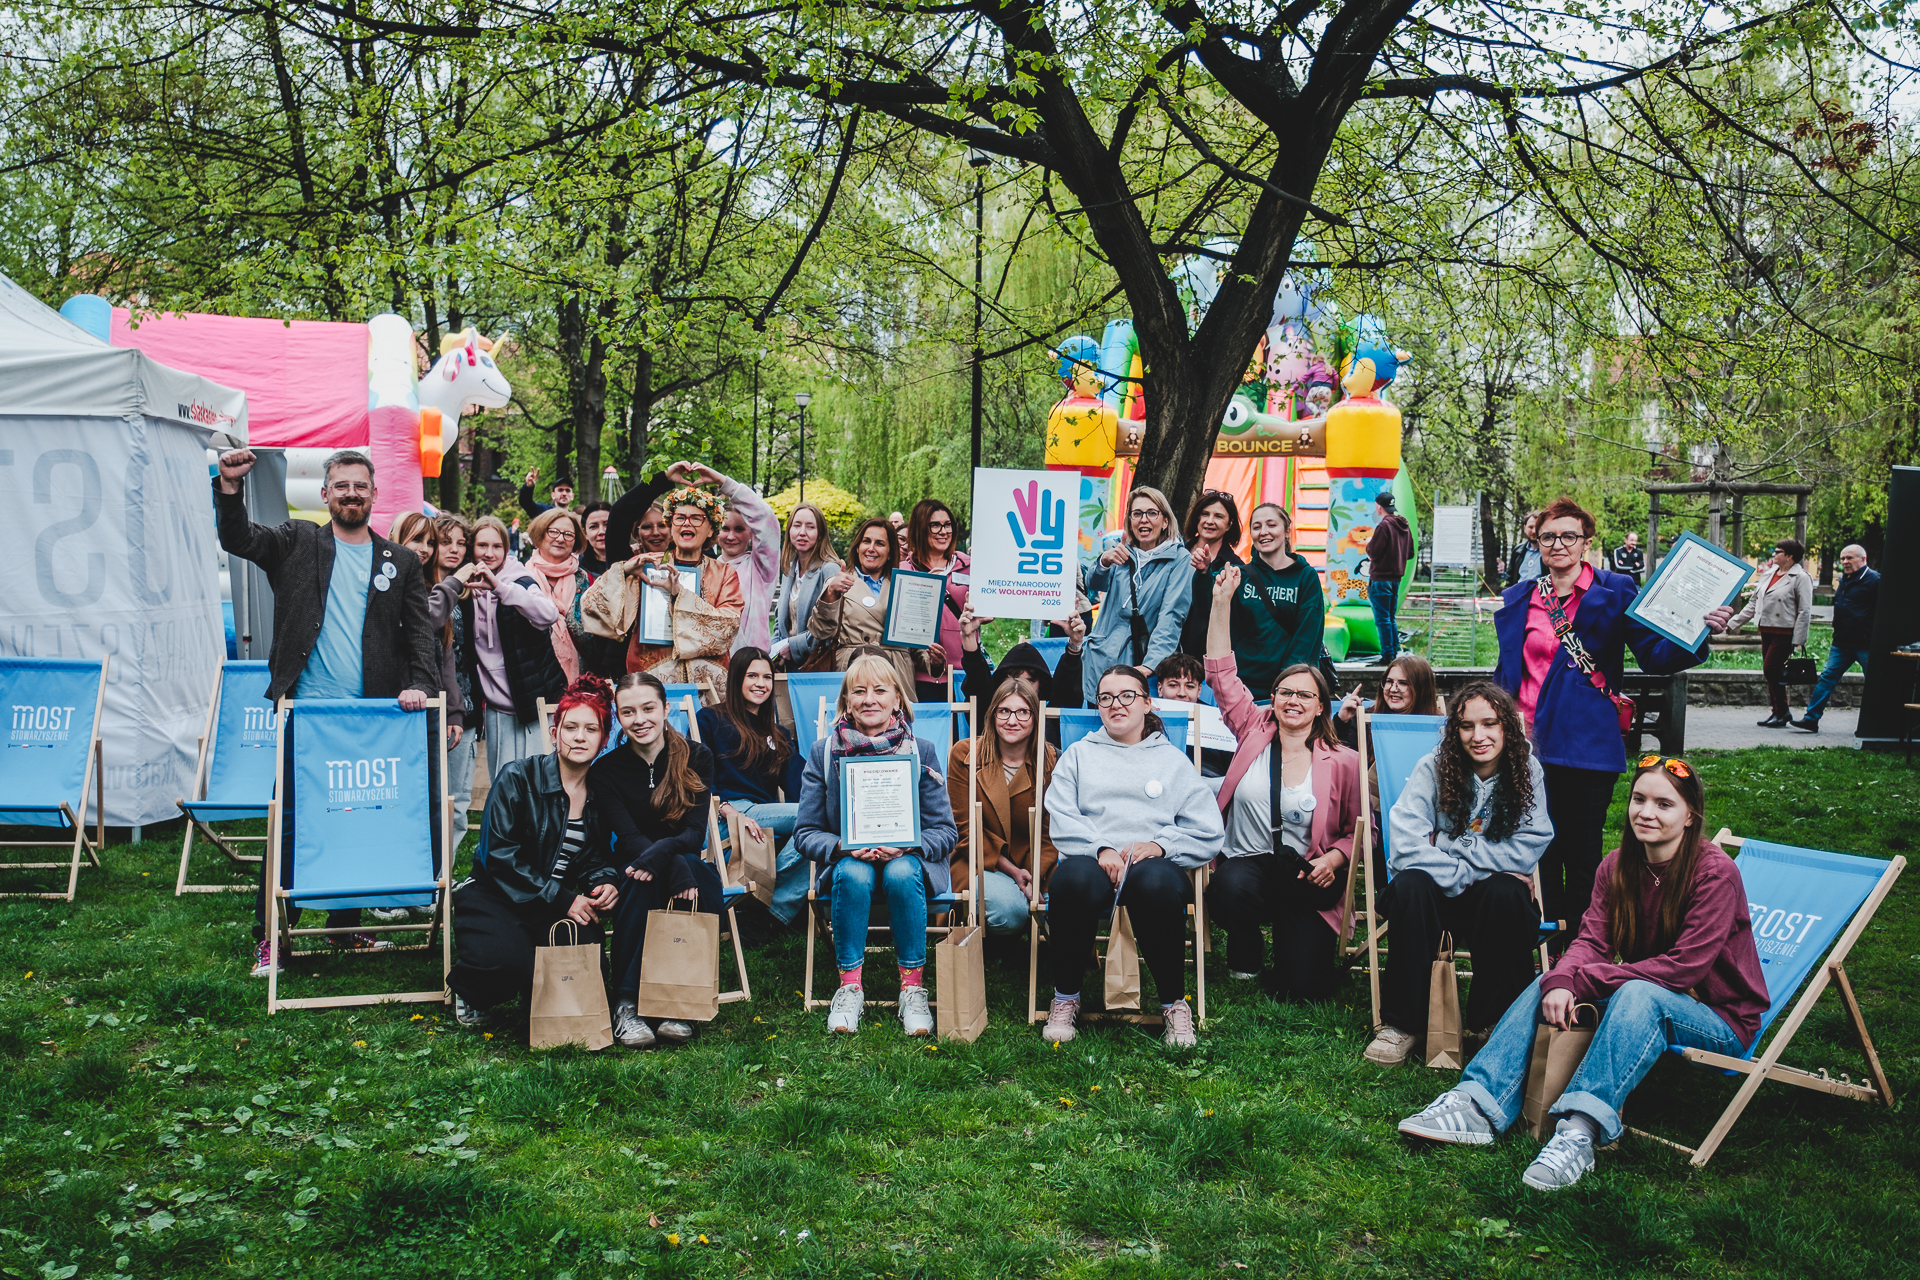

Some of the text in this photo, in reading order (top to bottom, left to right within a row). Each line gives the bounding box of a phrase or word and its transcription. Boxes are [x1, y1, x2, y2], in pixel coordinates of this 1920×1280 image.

[1217, 440, 1293, 453] BOUNCE
[1018, 552, 1063, 575] 26
[988, 579, 1062, 589] MIĘDZYNARODOWY
[981, 587, 1062, 597] ROK WOLONTARIATU
[1041, 598, 1061, 606] 2026
[10, 730, 70, 741] STOWARZYSZENIE
[243, 730, 278, 741] STOWARZY
[328, 787, 400, 803] STOWARZYSZENIE
